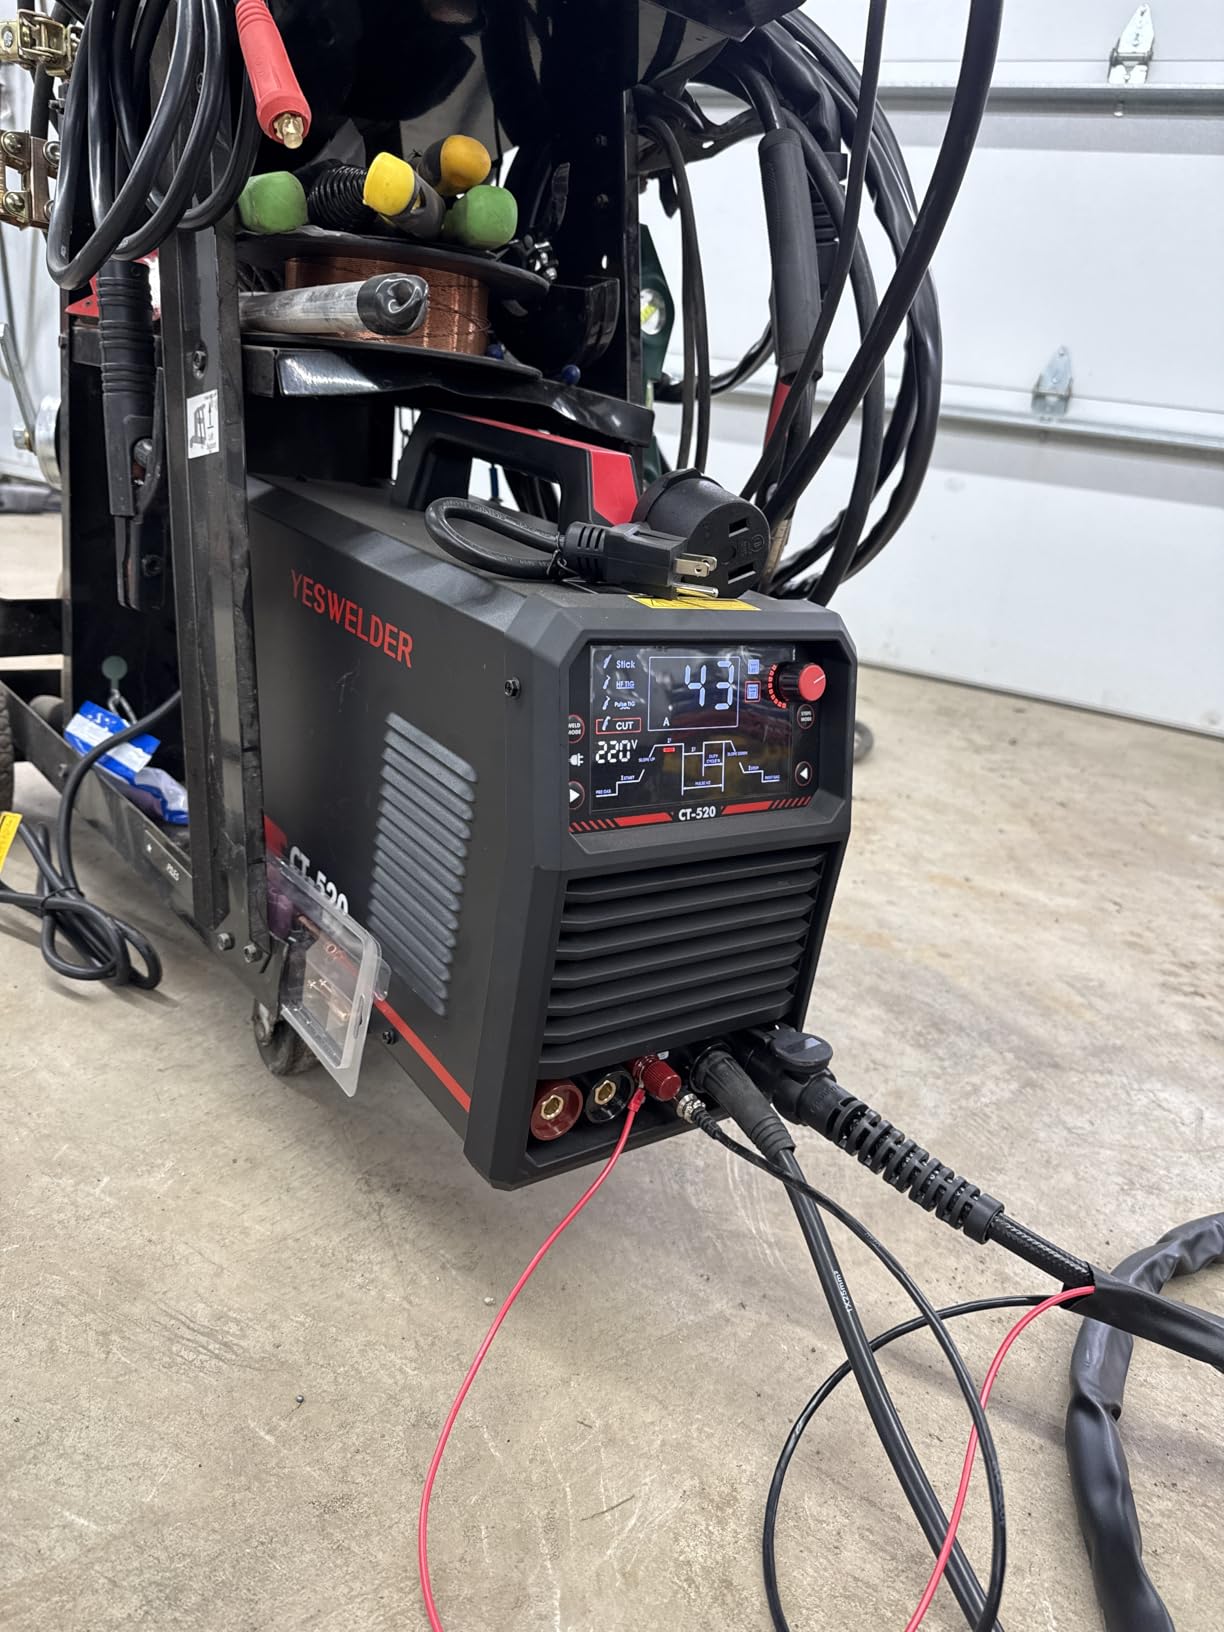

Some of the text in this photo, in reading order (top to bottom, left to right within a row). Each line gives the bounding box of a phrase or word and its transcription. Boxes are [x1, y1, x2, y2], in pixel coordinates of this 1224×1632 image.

[291, 569, 413, 669] YESWELDER
[616, 660, 636, 669] Stick
[684, 661, 734, 710] 43
[616, 721, 634, 730] CUT
[663, 717, 670, 727] A
[678, 805, 716, 821] CT-520
